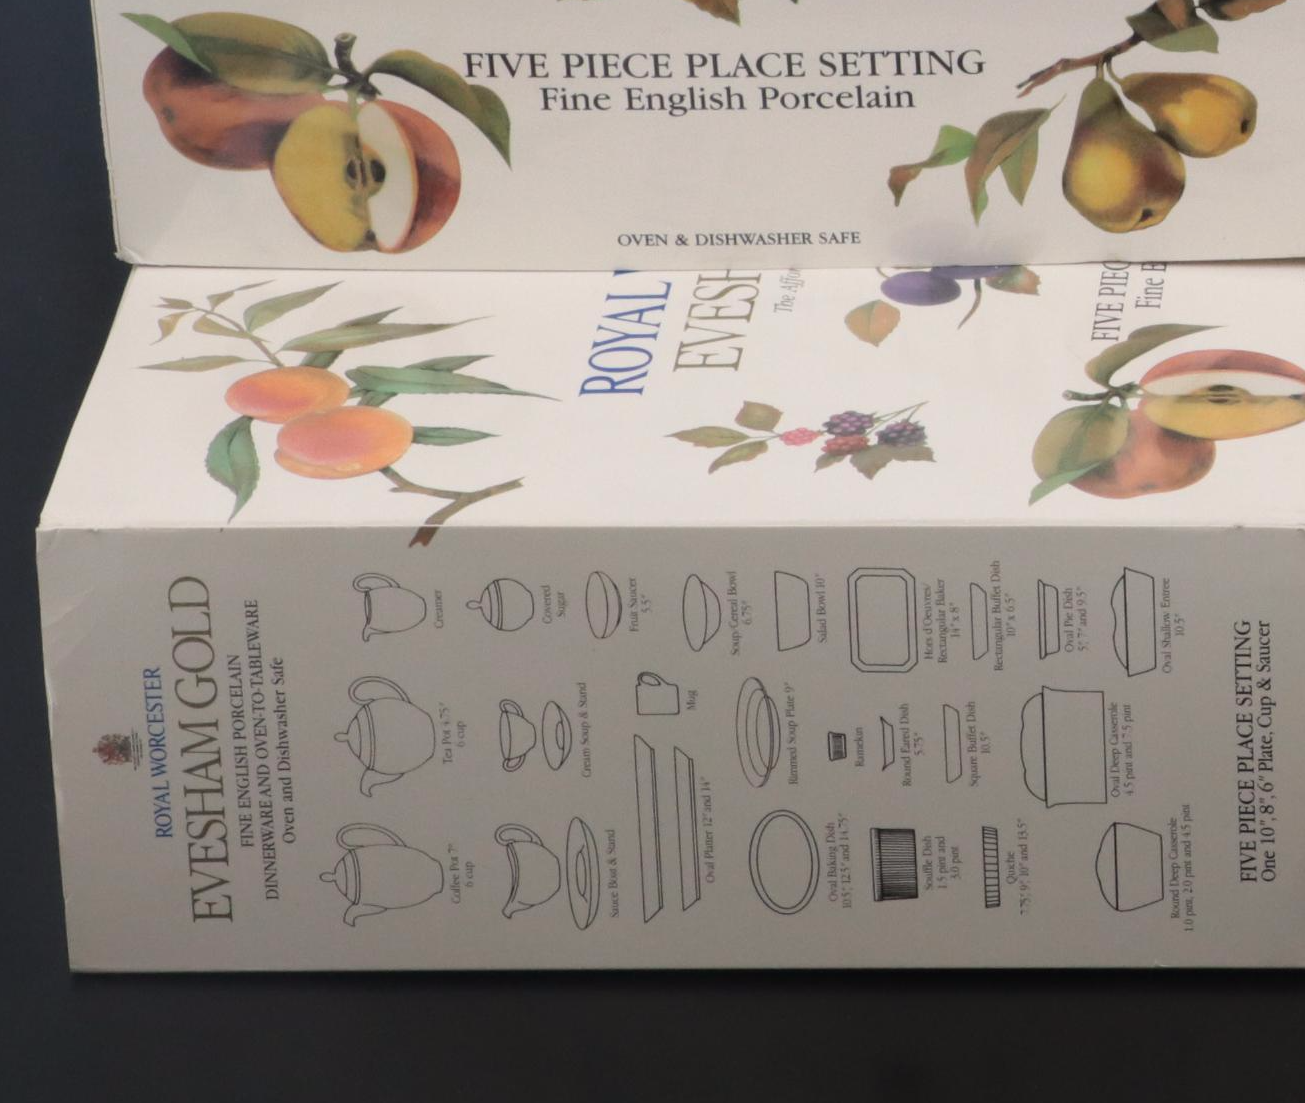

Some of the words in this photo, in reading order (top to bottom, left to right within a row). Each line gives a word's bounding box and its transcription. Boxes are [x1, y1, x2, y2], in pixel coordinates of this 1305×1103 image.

[464, 53, 549, 78] FIVE
[562, 53, 673, 79] PIECE
[686, 52, 806, 78] PLACE
[819, 49, 984, 77] SETTING
[540, 87, 611, 111] Fine
[625, 86, 746, 117] English
[760, 85, 915, 110] Porcelain
[617, 233, 668, 247] OVEN
[674, 234, 689, 246] &
[695, 232, 813, 246] DISHWASHER
[818, 231, 861, 245] SAFE
[579, 282, 672, 396] ROYAL
[433, 589, 445, 630] Creamer
[168, 575, 218, 710] GOLD
[1256, 620, 1271, 673] Saucer
[244, 600, 269, 760] OVEN-TO-TABLEWARE
[269, 657, 285, 685] Safe
[1234, 621, 1253, 707] SETTING
[227, 655, 247, 740] PORCELAIN
[686, 689, 698, 711] Mug
[1256, 678, 1272, 691] &
[143, 667, 168, 778] WORCESTER
[273, 689, 292, 772] Dishwasher
[1256, 695, 1277, 729] Cup
[1236, 713, 1255, 773] PLACE
[1257, 731, 1274, 772] Plate,
[234, 745, 252, 809] ENGLISH
[256, 763, 272, 798] AND
[278, 777, 294, 803] and
[152, 780, 174, 838] ROYAL
[178, 719, 234, 923] EVESHAM
[1237, 779, 1256, 834] PIECE
[238, 813, 255, 847] FINE
[282, 807, 296, 845] Oven
[604, 829, 616, 855] Stand
[258, 801, 280, 900] DINNERWARE
[449, 856, 460, 871] Pot
[607, 857, 617, 866] &
[1239, 841, 1258, 882] FIVE
[1260, 850, 1277, 883] One
[450, 874, 462, 905] Coffee
[607, 867, 618, 889] Boat
[610, 891, 620, 918] Sauce
